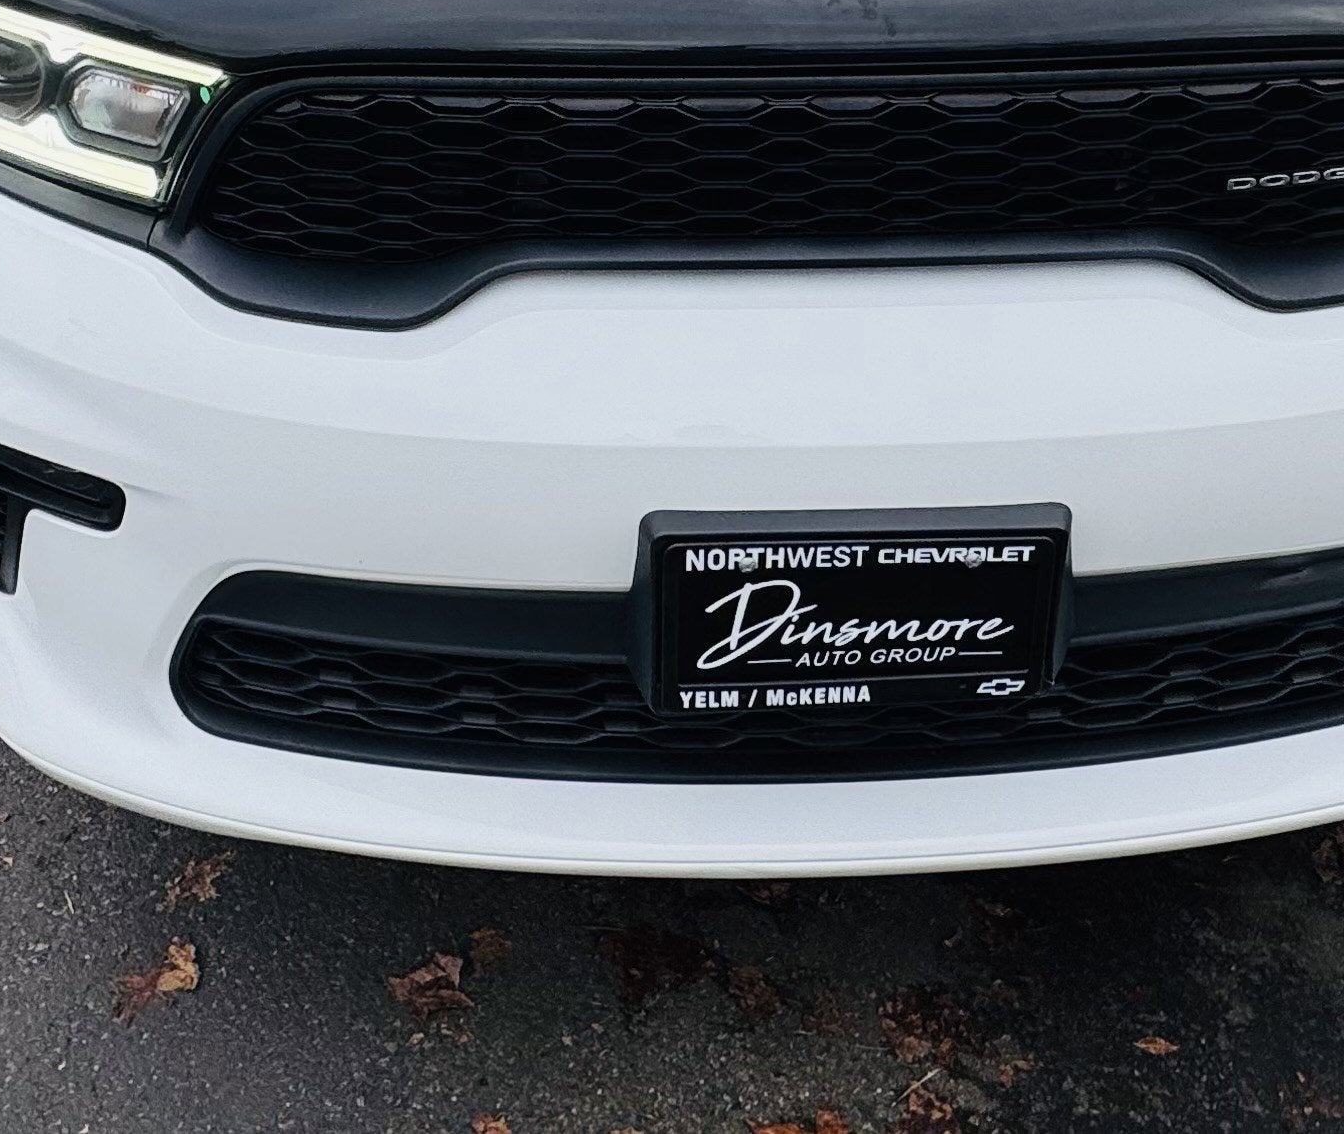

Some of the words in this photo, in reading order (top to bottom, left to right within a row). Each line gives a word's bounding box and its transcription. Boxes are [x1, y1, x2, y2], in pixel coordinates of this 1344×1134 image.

[685, 545, 870, 572] NORTHWEST
[696, 579, 1015, 670] Dinsmore
[795, 650, 862, 667] AUTO
[869, 647, 956, 664] GROUP
[679, 690, 740, 709] YELM
[765, 685, 871, 707] McKENNA
